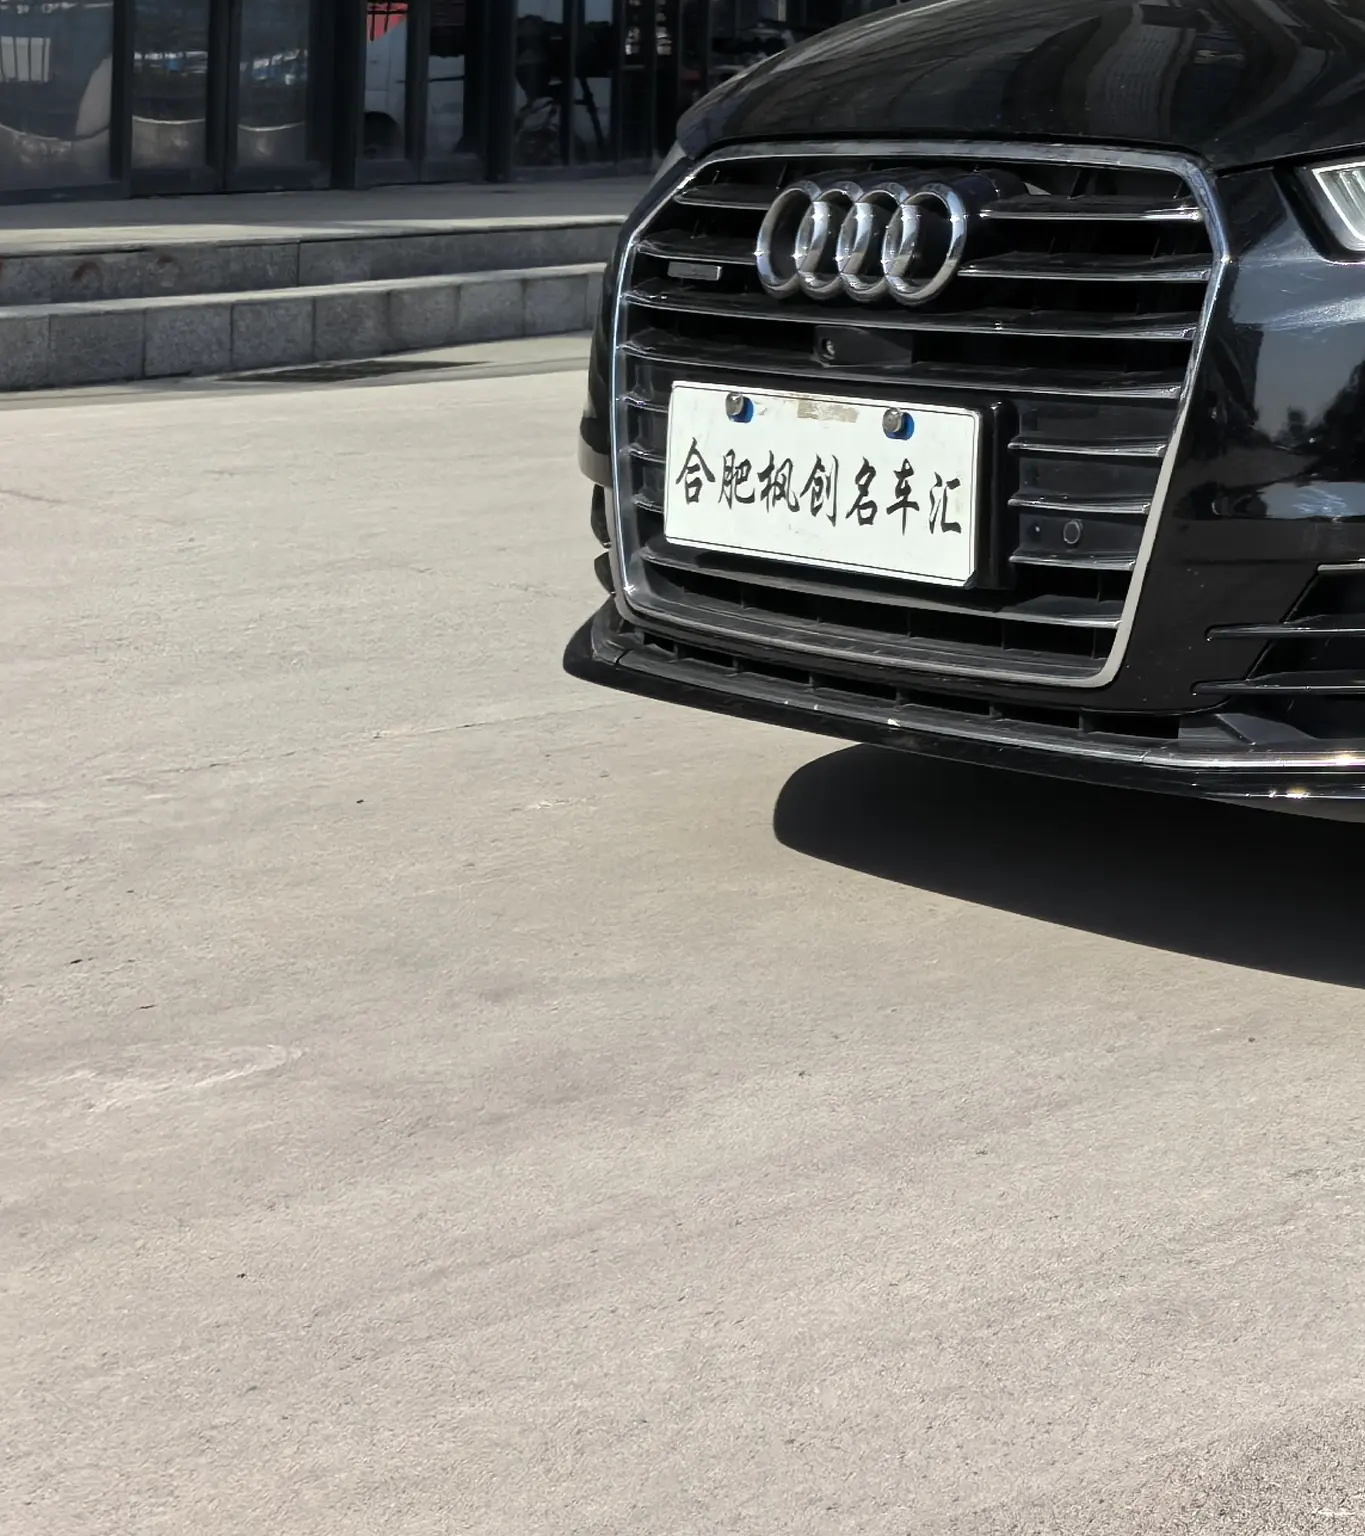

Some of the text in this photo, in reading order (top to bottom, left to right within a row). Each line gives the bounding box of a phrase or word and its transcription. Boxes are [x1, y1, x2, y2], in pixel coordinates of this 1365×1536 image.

[676, 437, 961, 535] 合肥枫创名车汇
